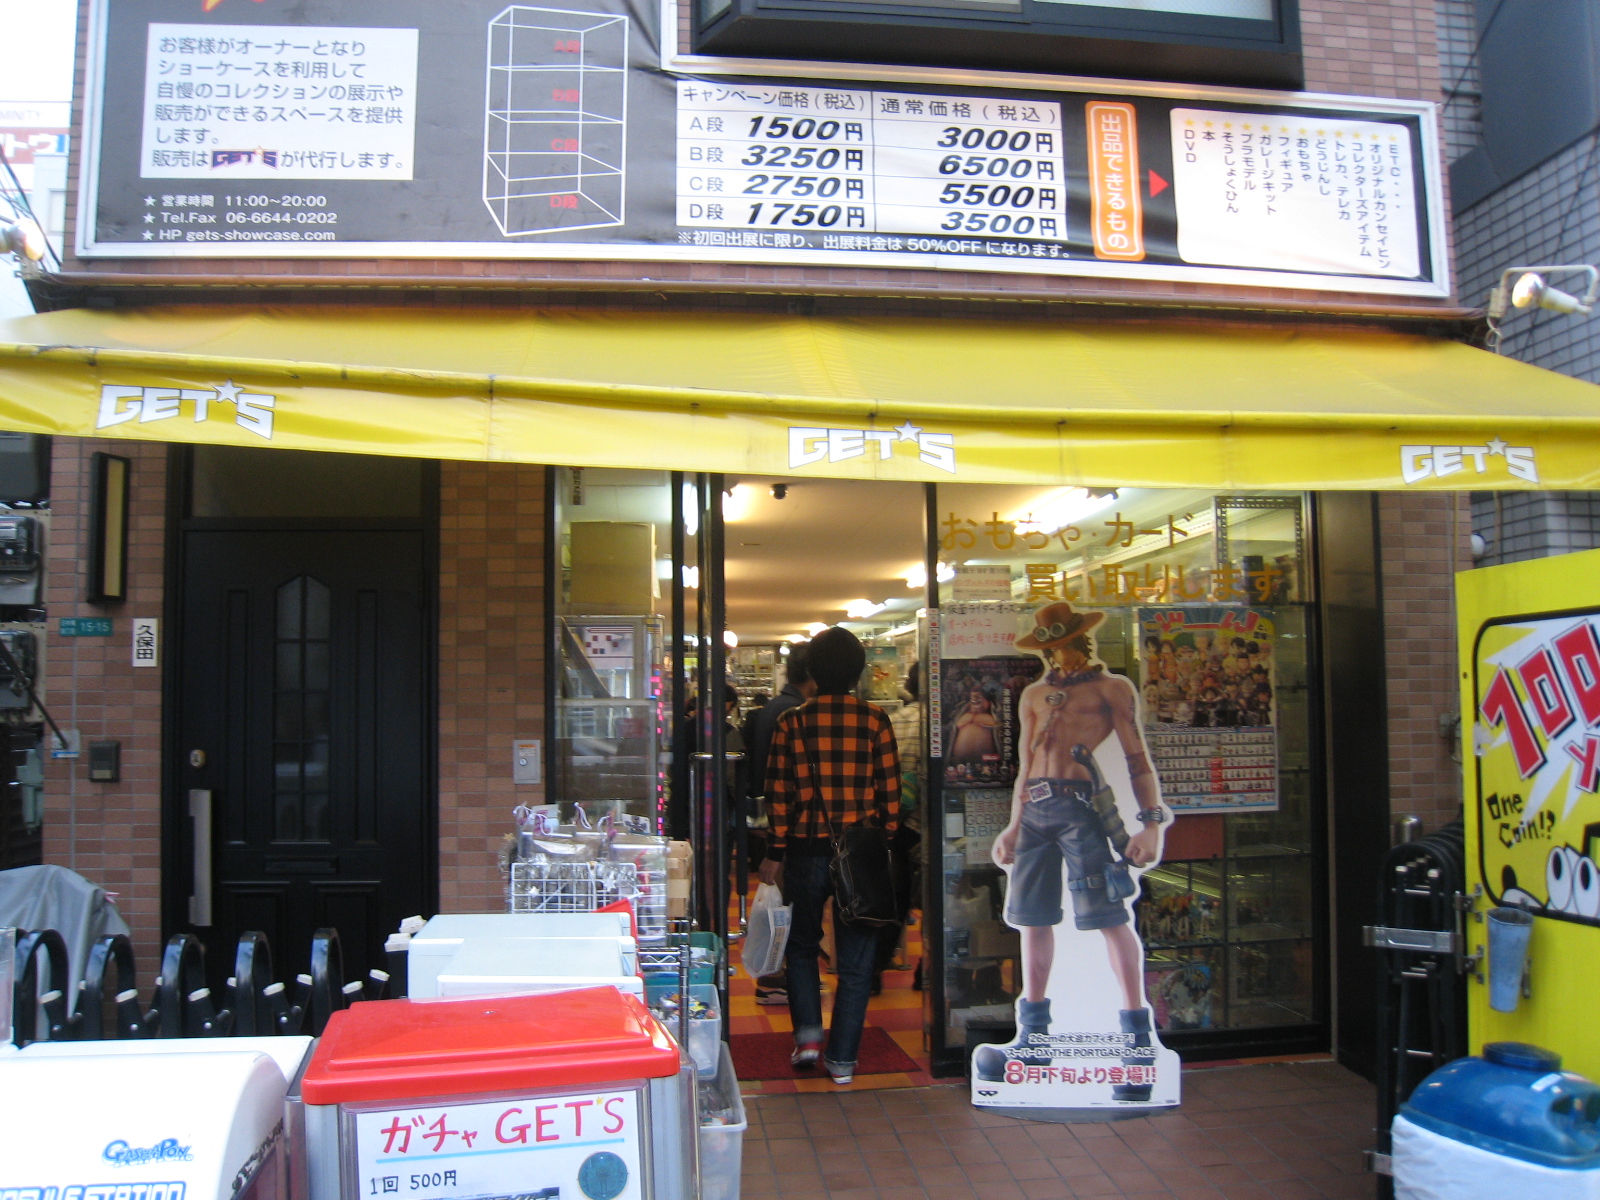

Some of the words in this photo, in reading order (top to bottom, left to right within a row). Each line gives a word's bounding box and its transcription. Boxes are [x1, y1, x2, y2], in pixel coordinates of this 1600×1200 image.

[159, 36, 366, 57] お客様がオーナーとなり
[158, 58, 367, 79] ショーケースを利用して
[157, 81, 404, 103] 自慢のコレクションの展示や
[154, 104, 404, 125] 販売ができるスペースを提供
[155, 127, 220, 146] します。
[689, 116, 724, 134] A段
[746, 115, 864, 142] 1500円
[936, 127, 1054, 154] 3000円
[1184, 129, 1197, 163] DVD
[1202, 130, 1216, 141] 本
[689, 145, 724, 164] B段
[741, 144, 864, 171] 3250円
[938, 154, 1056, 182] 6500円
[1222, 131, 1239, 213] そうしょくひん
[1259, 134, 1277, 215] ガレージキット
[1278, 136, 1294, 192] フィギュア
[1296, 138, 1312, 182] おもちゃ
[1315, 138, 1331, 196] どうじんし
[689, 175, 724, 194] C段
[742, 174, 865, 200] 2750円
[938, 183, 1056, 211] 5500円
[1100, 113, 1129, 249] 出品できるもの
[1335, 140, 1351, 221] トレカ、テレカ
[161, 195, 215, 208] 営業時間
[1351, 142, 1372, 257] コレクターズアイテム
[1369, 143, 1391, 269] オリジナルカンセイヒン
[158, 229, 182, 241] HP
[186, 229, 336, 242] gets-showcase.com
[160, 212, 217, 224] Tel.Fax
[225, 212, 338, 224] 06-6644-0202
[689, 202, 724, 221] D段
[746, 202, 865, 229] 1750円
[940, 211, 1058, 238] 3500円
[941, 511, 1193, 551] おもちゃ・カード
[1025, 562, 1283, 602] 買い取りします
[137, 624, 154, 660] 久保田
[1486, 792, 1523, 820] One
[1006, 1061, 1157, 1084] 8月下旬より登場!!
[380, 1113, 478, 1154] ガチャ
[370, 1174, 399, 1195] 1回
[409, 1169, 457, 1189] 500円
